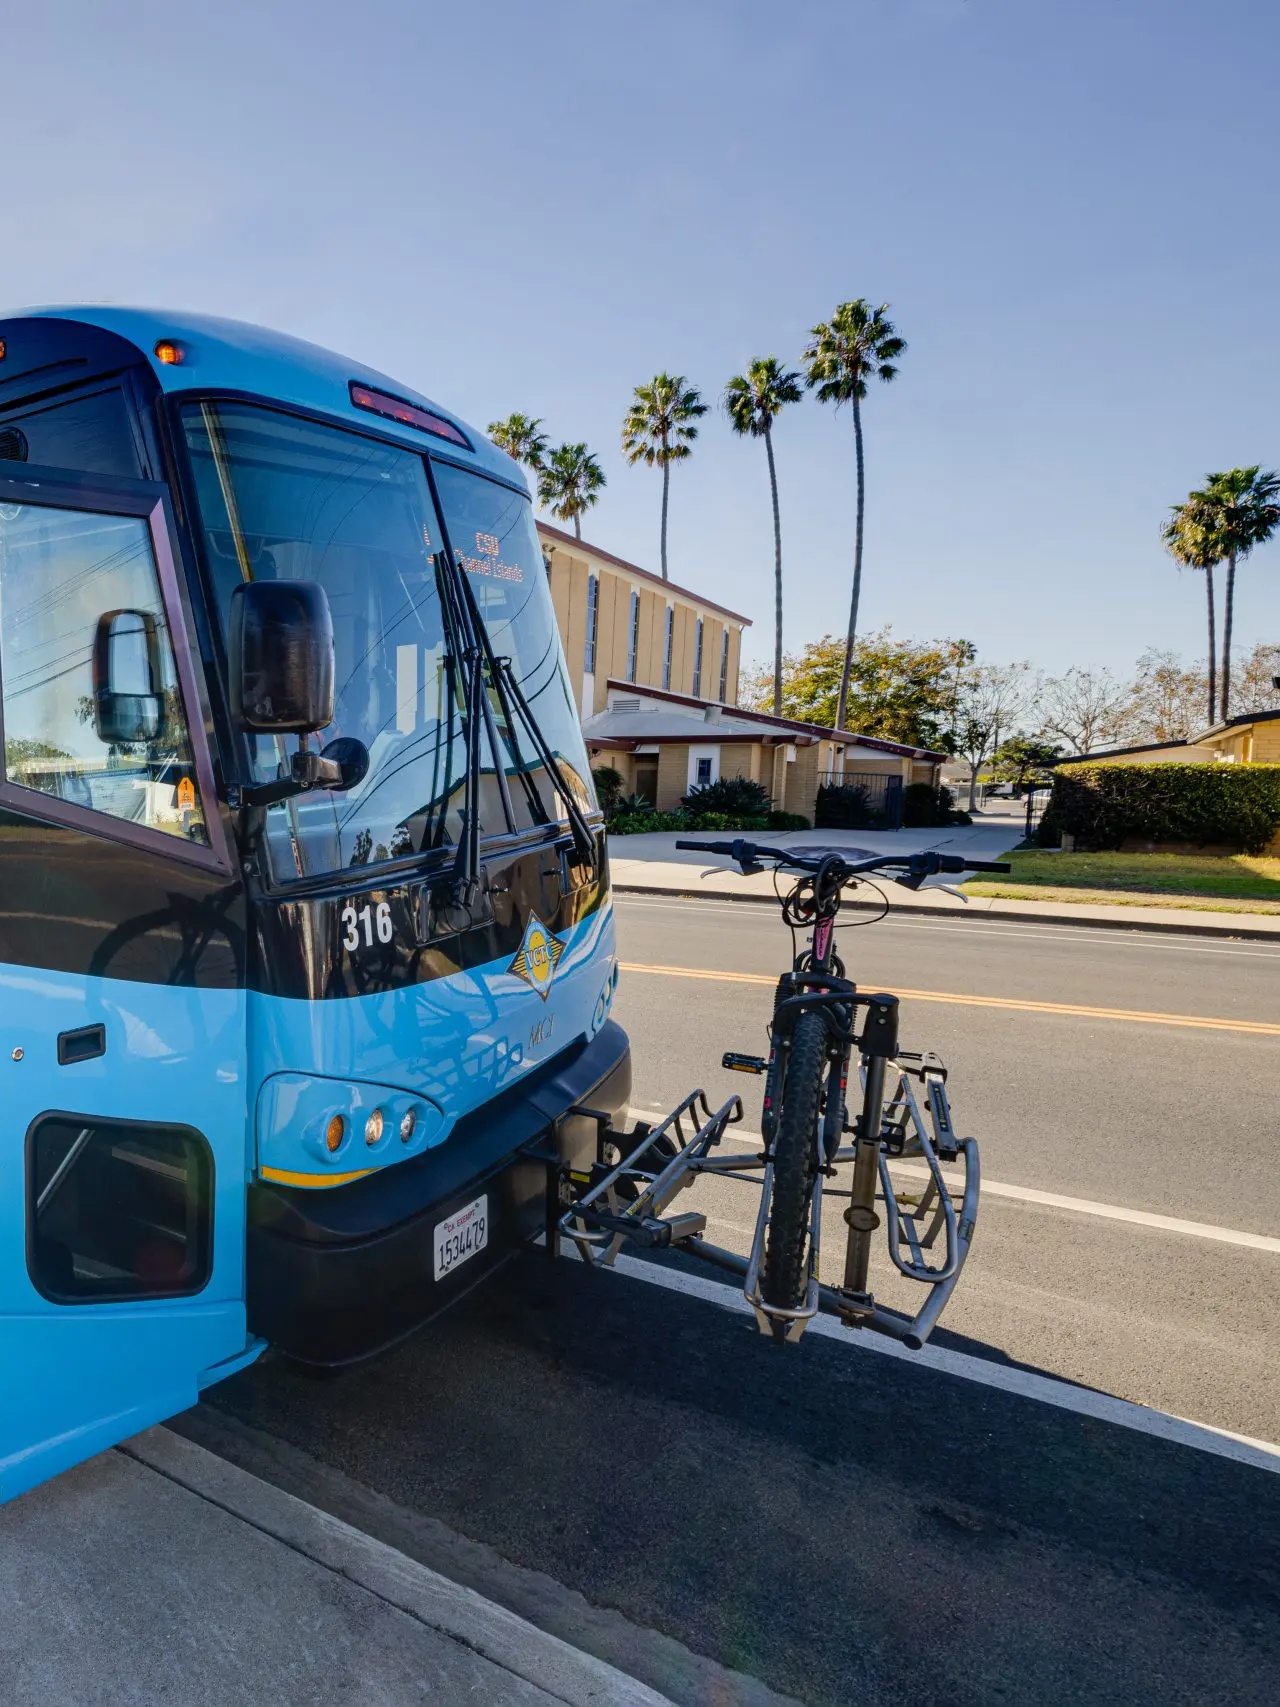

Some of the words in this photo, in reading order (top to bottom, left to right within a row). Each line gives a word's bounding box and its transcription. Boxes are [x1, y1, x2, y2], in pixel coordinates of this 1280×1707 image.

[475, 532, 499, 556] CSU
[491, 557, 524, 583] Islands
[341, 901, 393, 951] 316
[525, 943, 554, 971] VCTC
[528, 1012, 556, 1050] MCI
[456, 1208, 476, 1227] EXEMPT
[439, 1217, 485, 1271] 1534479
